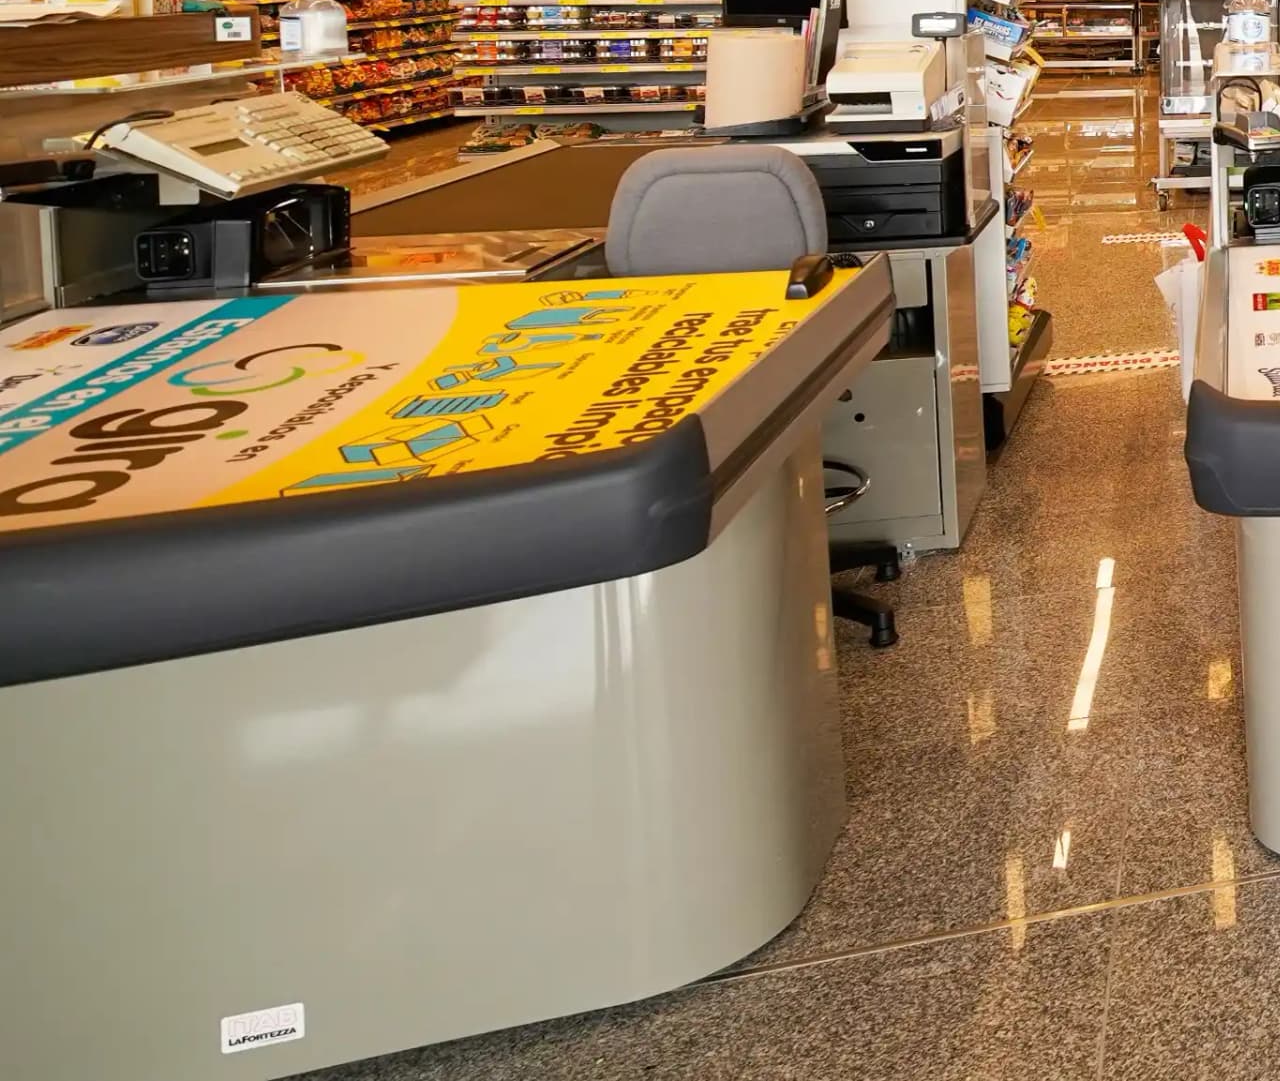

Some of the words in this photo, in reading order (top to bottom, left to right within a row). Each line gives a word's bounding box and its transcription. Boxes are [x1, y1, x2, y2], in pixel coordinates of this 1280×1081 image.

[719, 308, 780, 342] trae
[87, 317, 256, 387] Estamos
[366, 362, 400, 370] Y
[601, 311, 705, 400] reciclables
[696, 337, 749, 365] tus
[38, 386, 106, 410] en
[0, 400, 250, 517] gira
[226, 444, 269, 463] en
